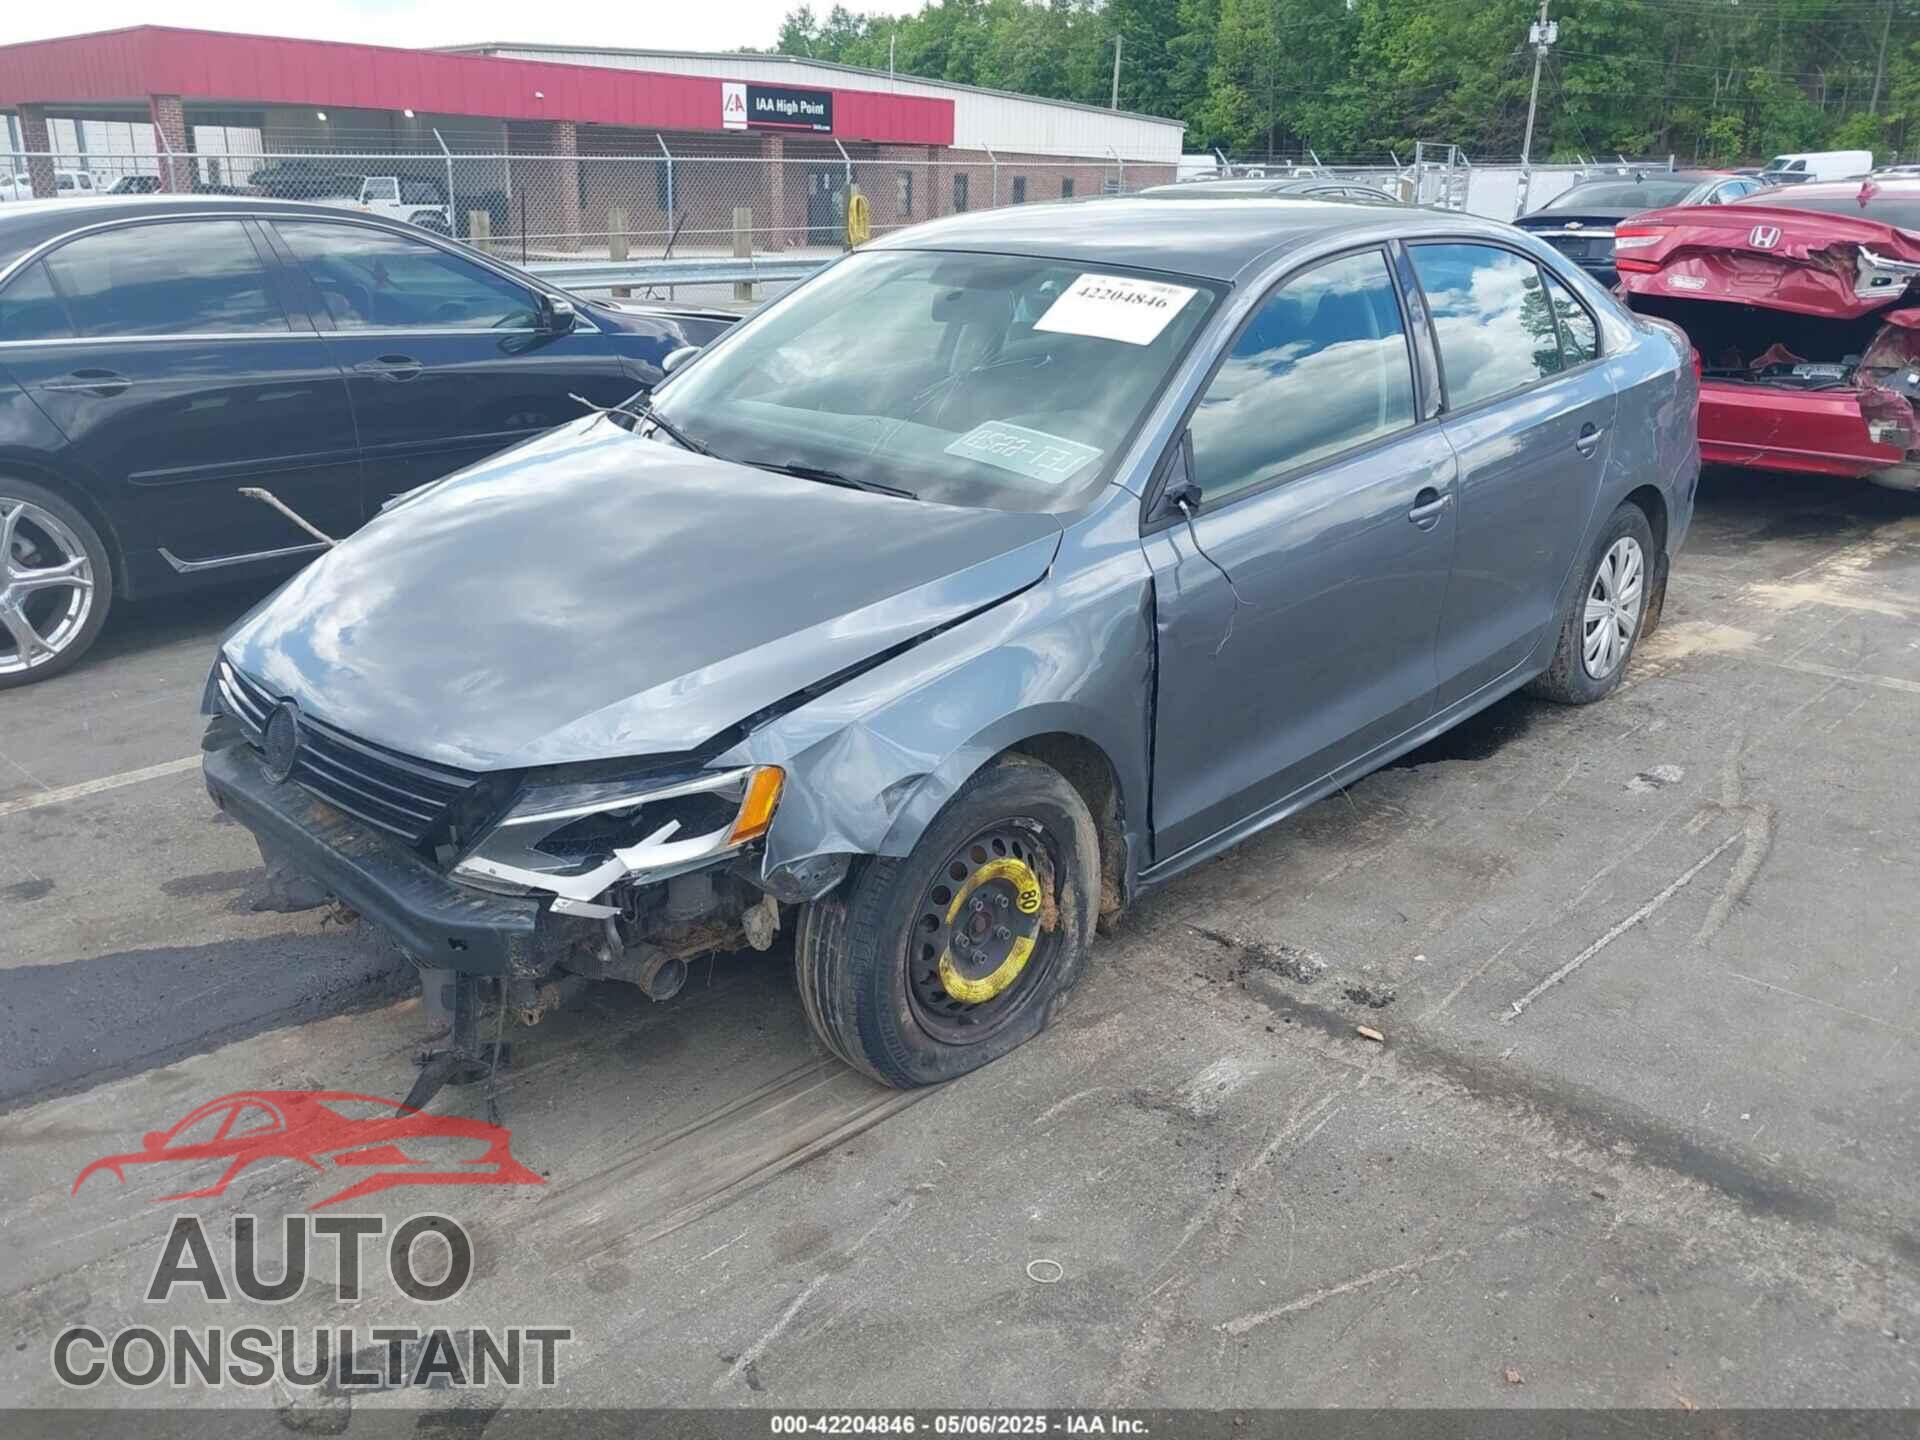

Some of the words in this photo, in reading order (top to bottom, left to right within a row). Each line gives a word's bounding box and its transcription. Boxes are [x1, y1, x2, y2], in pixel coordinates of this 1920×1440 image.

[756, 97, 775, 111] IAA
[776, 99, 798, 115] High
[800, 100, 824, 115] Point
[1076, 286, 1168, 309] 42204846
[1020, 889, 1037, 910] 80
